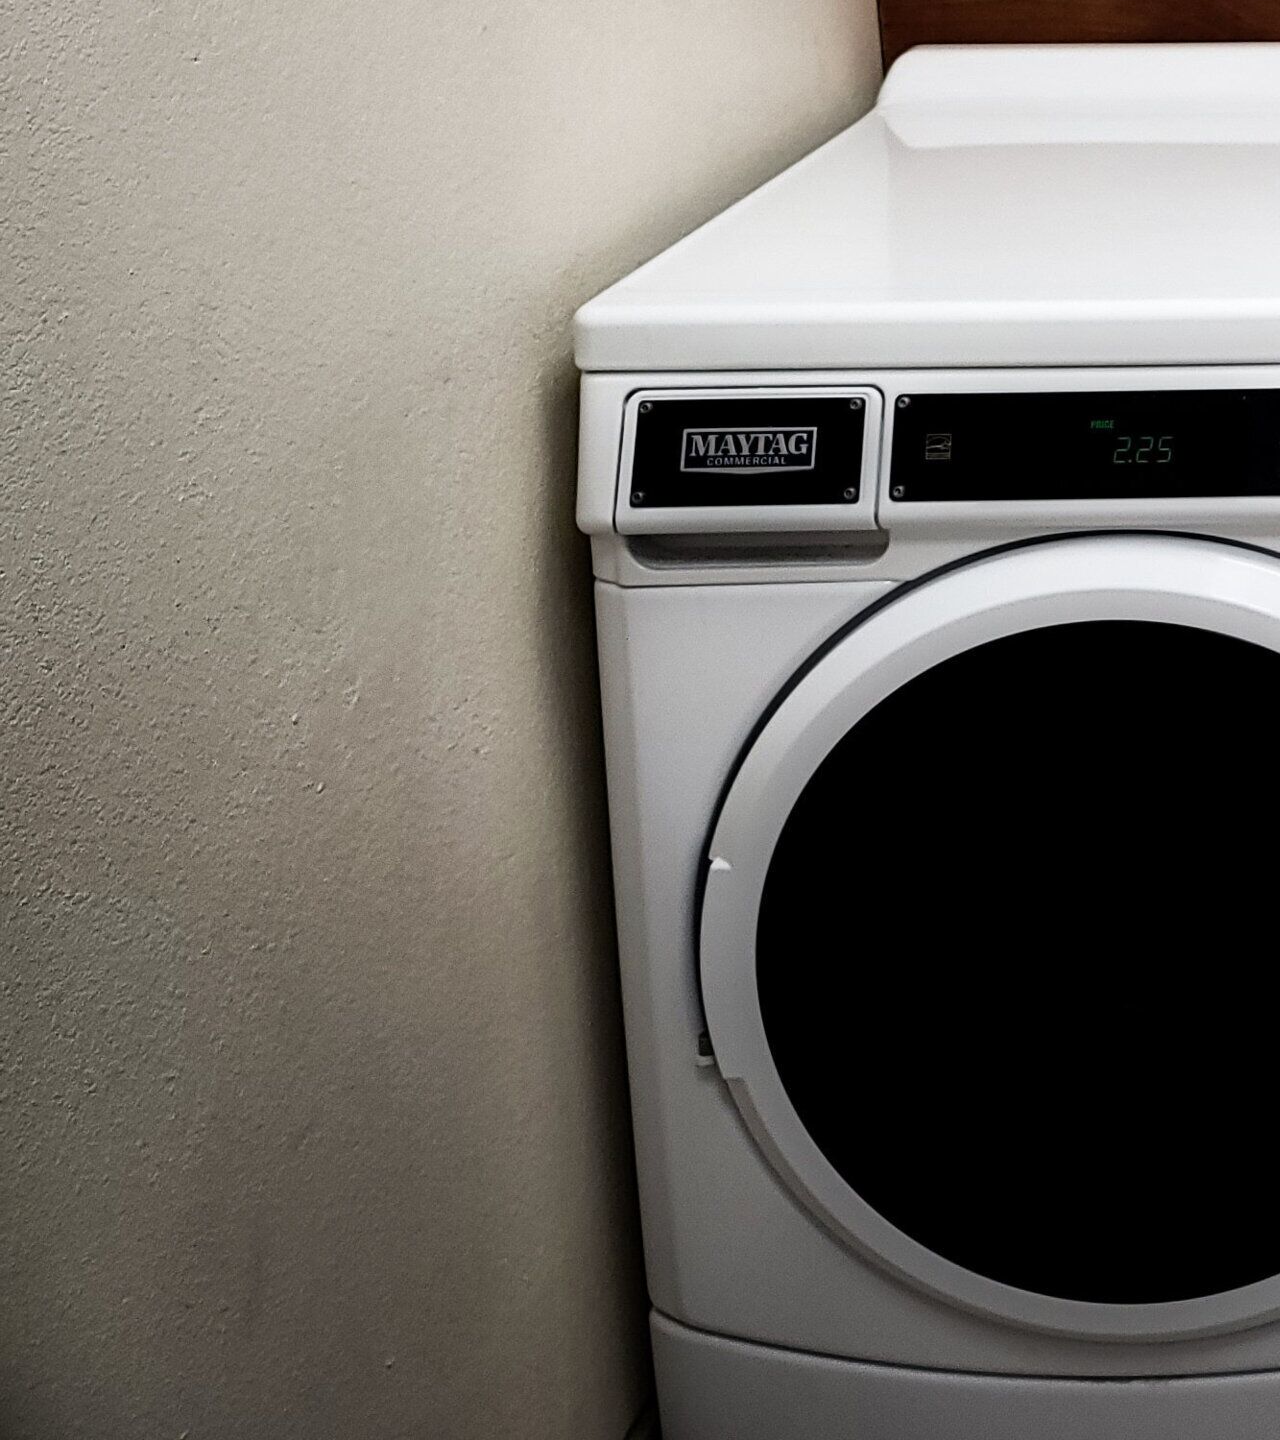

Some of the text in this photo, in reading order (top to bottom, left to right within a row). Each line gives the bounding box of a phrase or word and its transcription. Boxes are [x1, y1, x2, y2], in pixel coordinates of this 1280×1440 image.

[688, 433, 809, 457] MAYTAG
[1112, 436, 1174, 464] 2.25
[706, 456, 787, 466] COMMERCIAL
